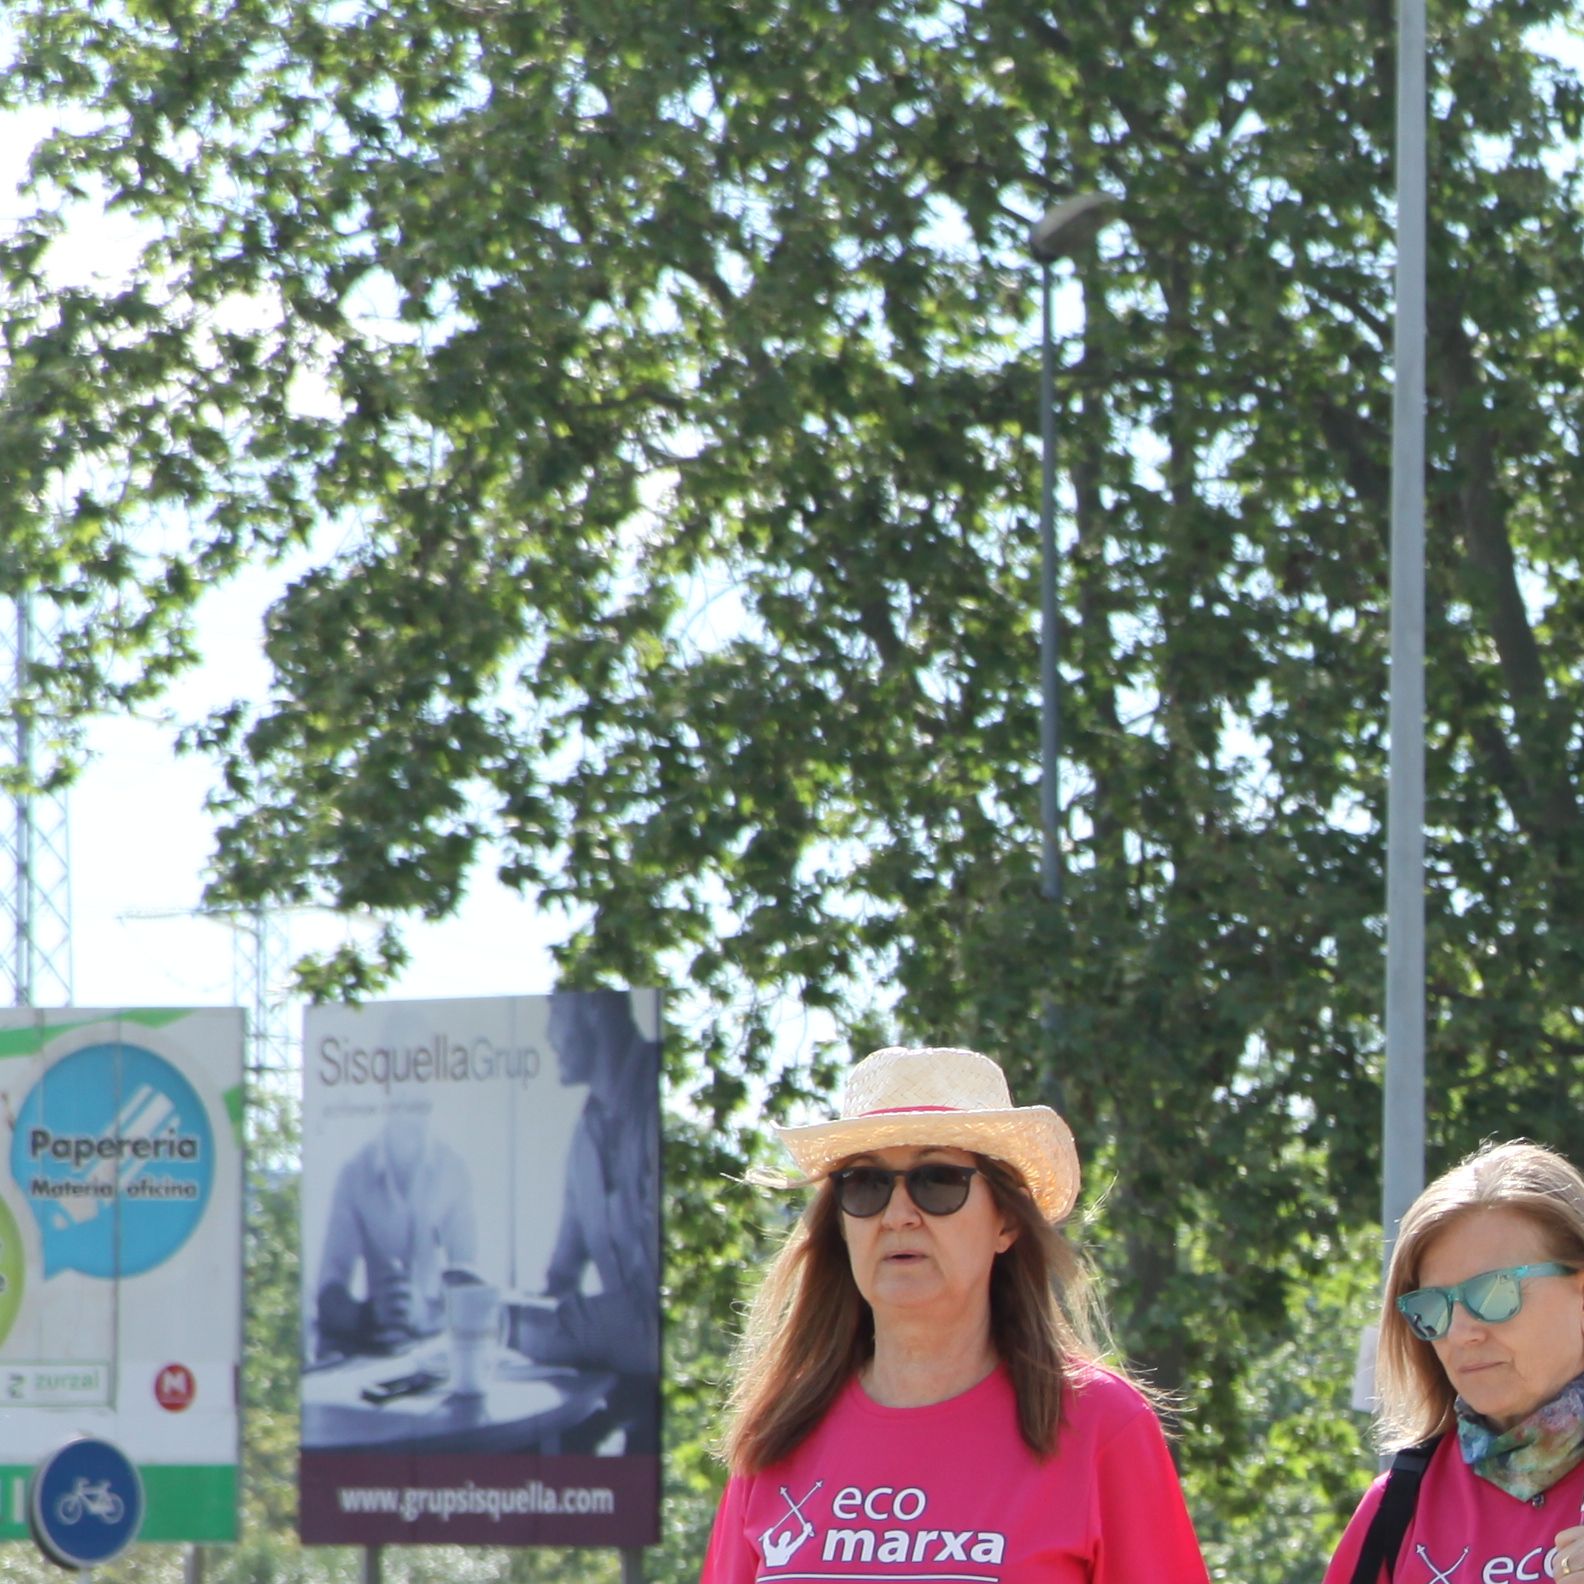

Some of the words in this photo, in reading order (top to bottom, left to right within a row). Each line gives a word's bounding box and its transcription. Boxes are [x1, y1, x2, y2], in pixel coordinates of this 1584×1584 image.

[31, 1128, 197, 1167] Papereria
[339, 1480, 615, 1522] www.grupsisquella.com
[832, 1486, 927, 1521] eco
[822, 1528, 1005, 1565] marxa
